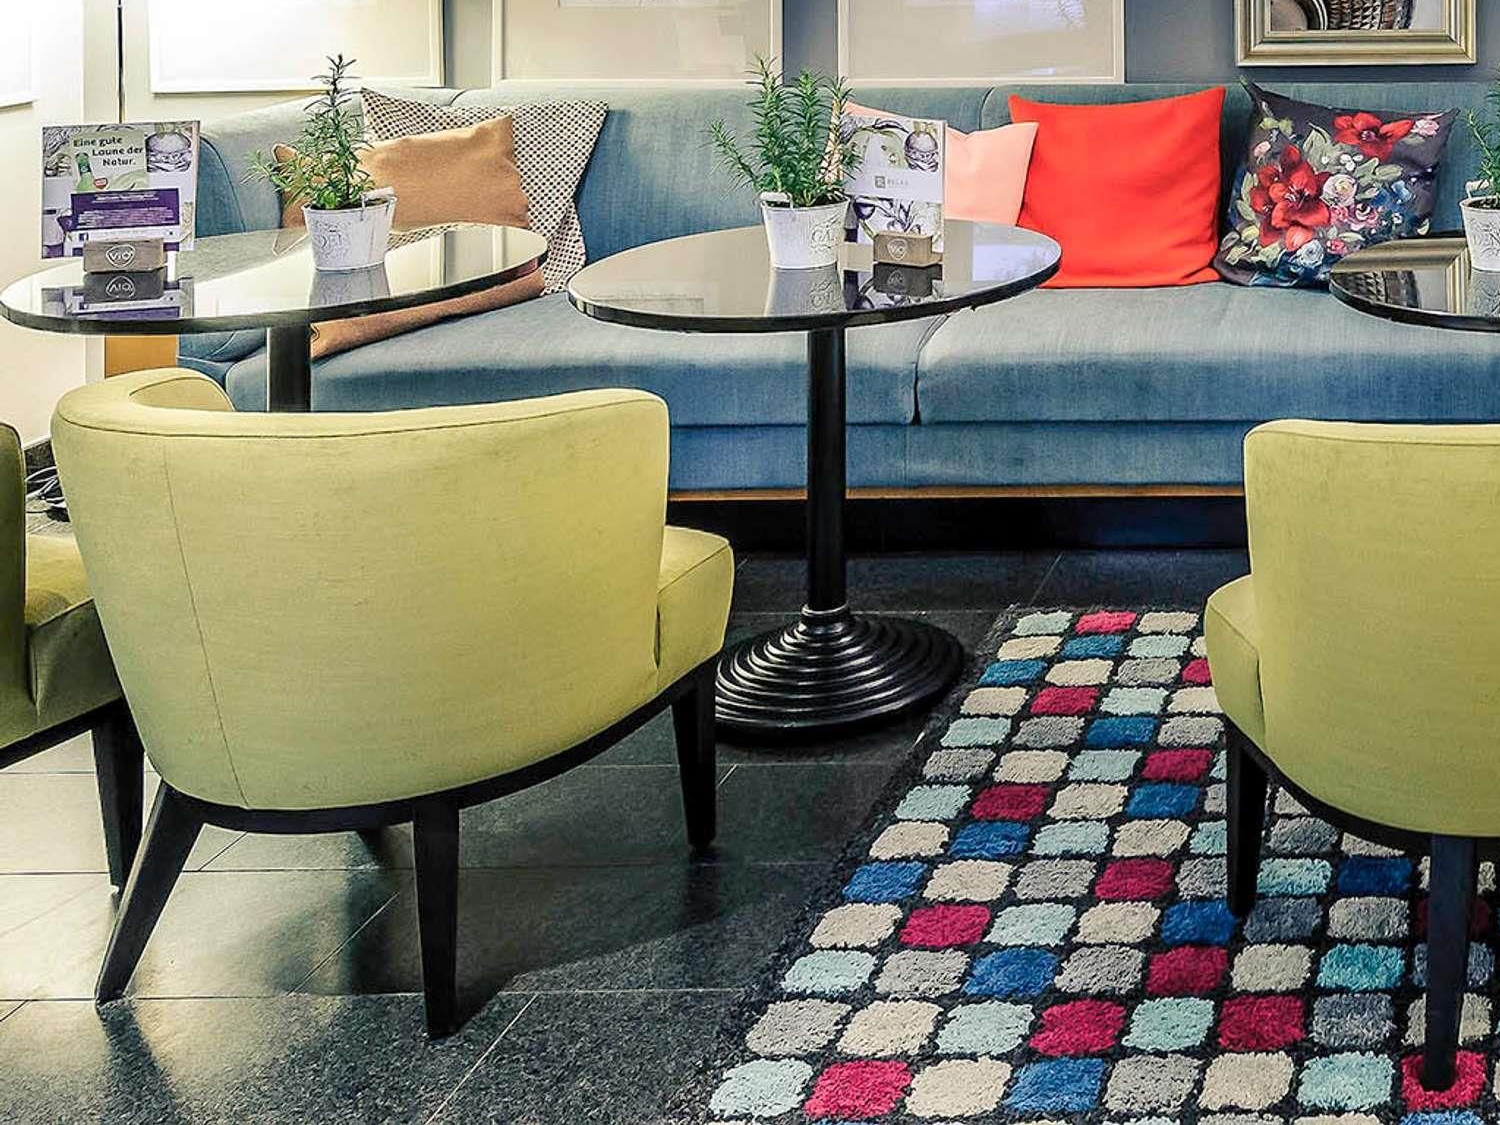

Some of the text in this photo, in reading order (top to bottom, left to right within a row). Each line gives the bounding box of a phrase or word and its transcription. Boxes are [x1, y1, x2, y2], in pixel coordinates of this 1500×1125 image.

[73, 136, 123, 148] Eine gute
[92, 145, 144, 157] Laune der
